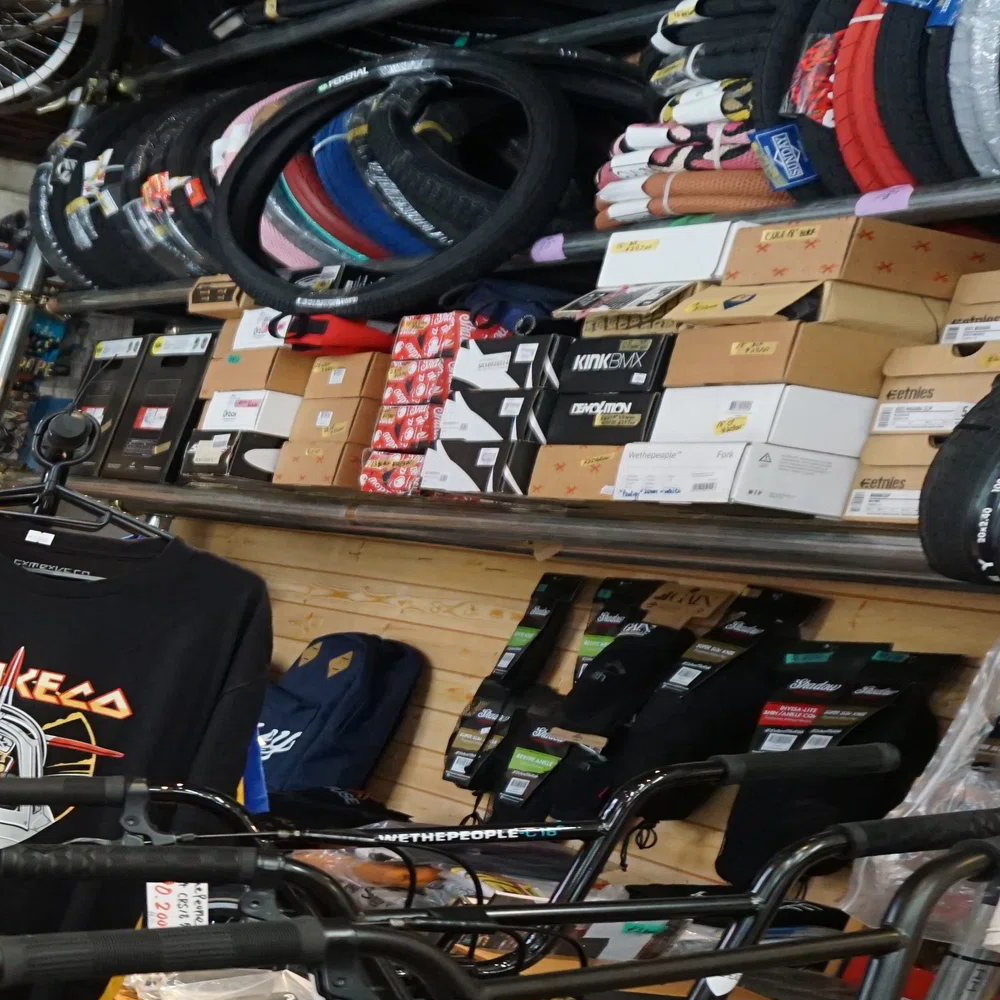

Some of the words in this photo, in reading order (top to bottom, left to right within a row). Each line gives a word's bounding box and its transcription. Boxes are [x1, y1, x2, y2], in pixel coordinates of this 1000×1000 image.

[328, 66, 369, 88] FEDERAL
[772, 132, 803, 179] SUNDAY
[896, 386, 935, 400] etnies
[569, 401, 633, 415] DEMOLITION
[716, 450, 735, 459] Fork
[868, 476, 907, 489] etnies
[790, 678, 843, 693] Shadow
